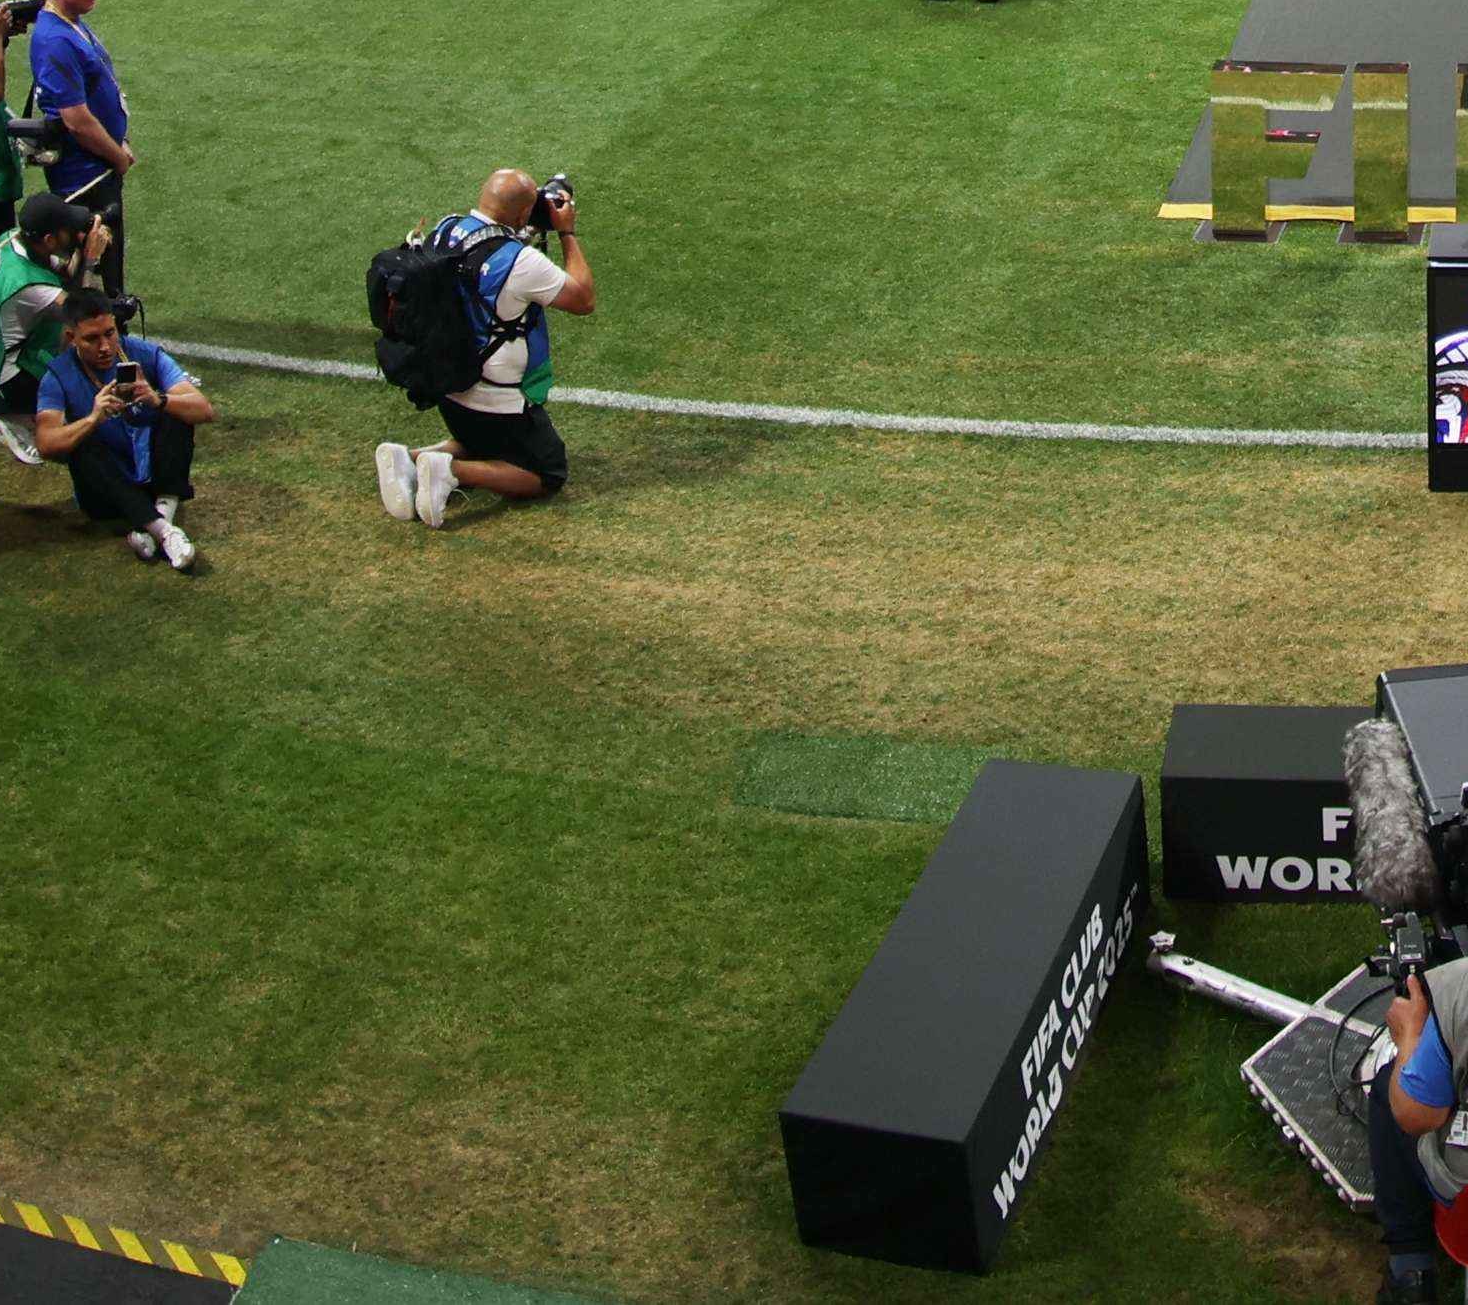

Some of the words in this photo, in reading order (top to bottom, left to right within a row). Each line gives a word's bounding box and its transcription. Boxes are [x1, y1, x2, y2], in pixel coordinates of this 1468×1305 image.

[1216, 855, 1363, 891] WOR
[1020, 999, 1062, 1100] FIFA
[1060, 902, 1104, 1009] CLUB
[993, 1062, 1063, 1220] WORLD
[1061, 983, 1096, 1071] CUP
